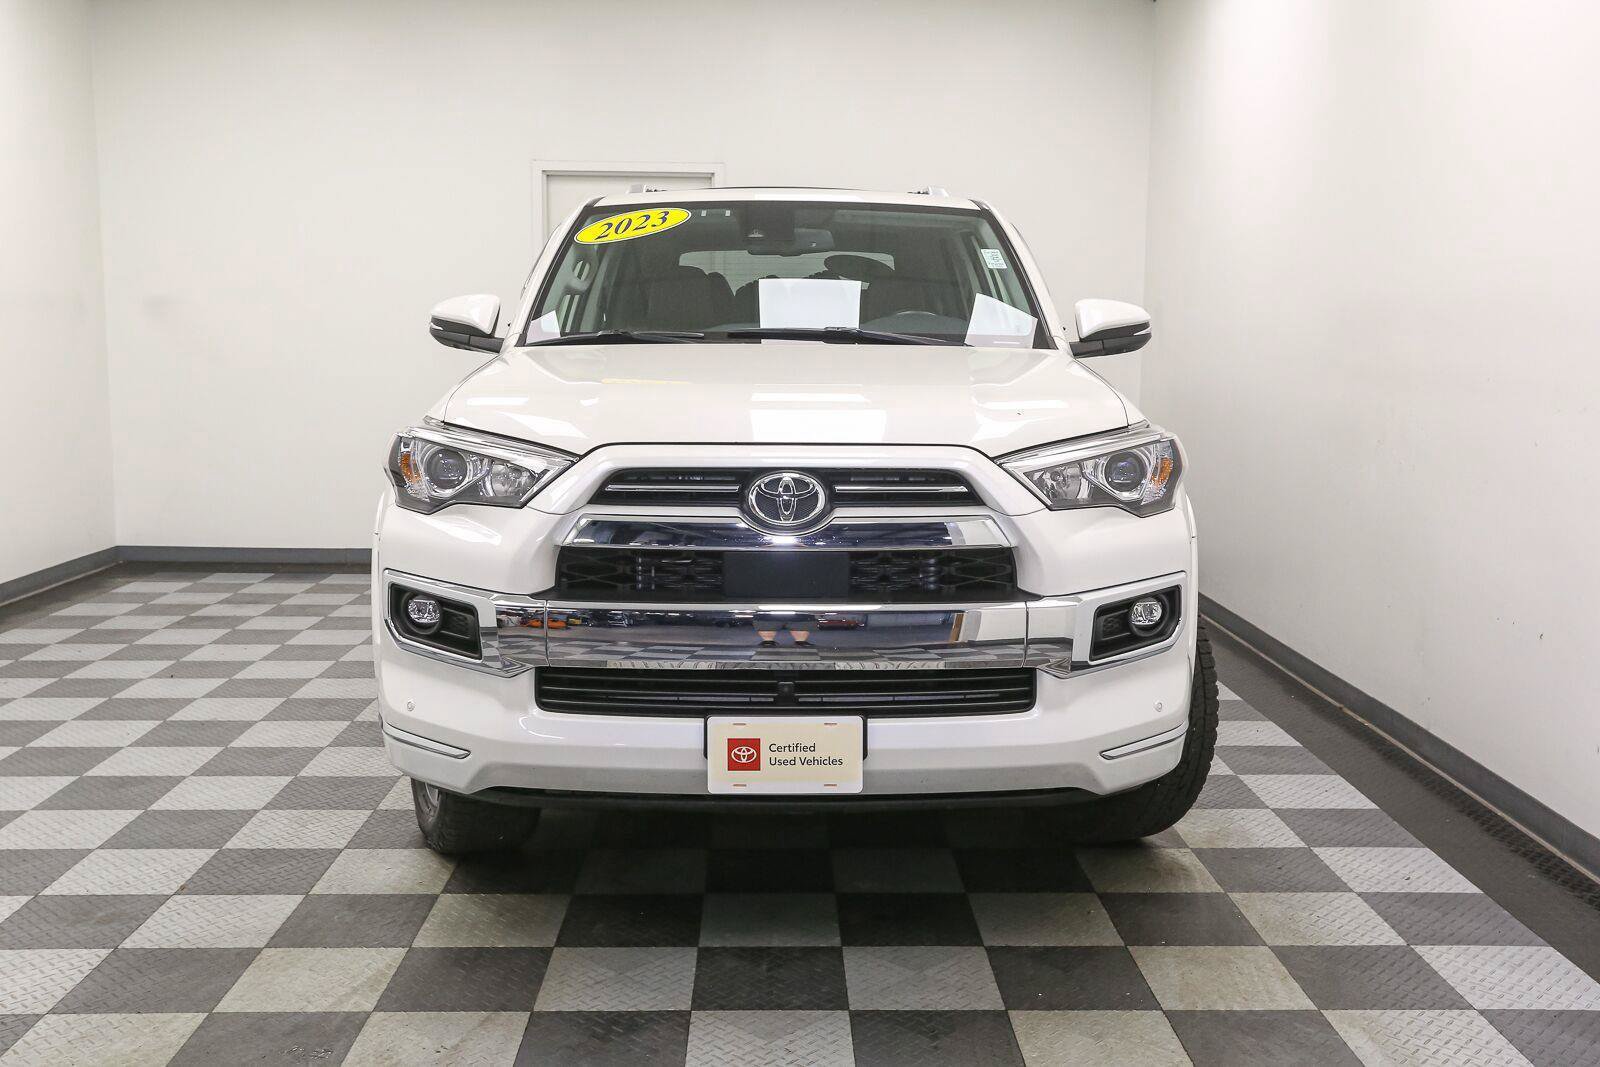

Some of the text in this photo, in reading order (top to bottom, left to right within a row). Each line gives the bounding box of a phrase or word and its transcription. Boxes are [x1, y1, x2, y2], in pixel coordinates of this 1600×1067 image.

[594, 211, 670, 240] 2023
[768, 743, 816, 753] Certified
[769, 756, 844, 766] Used Vehicles
